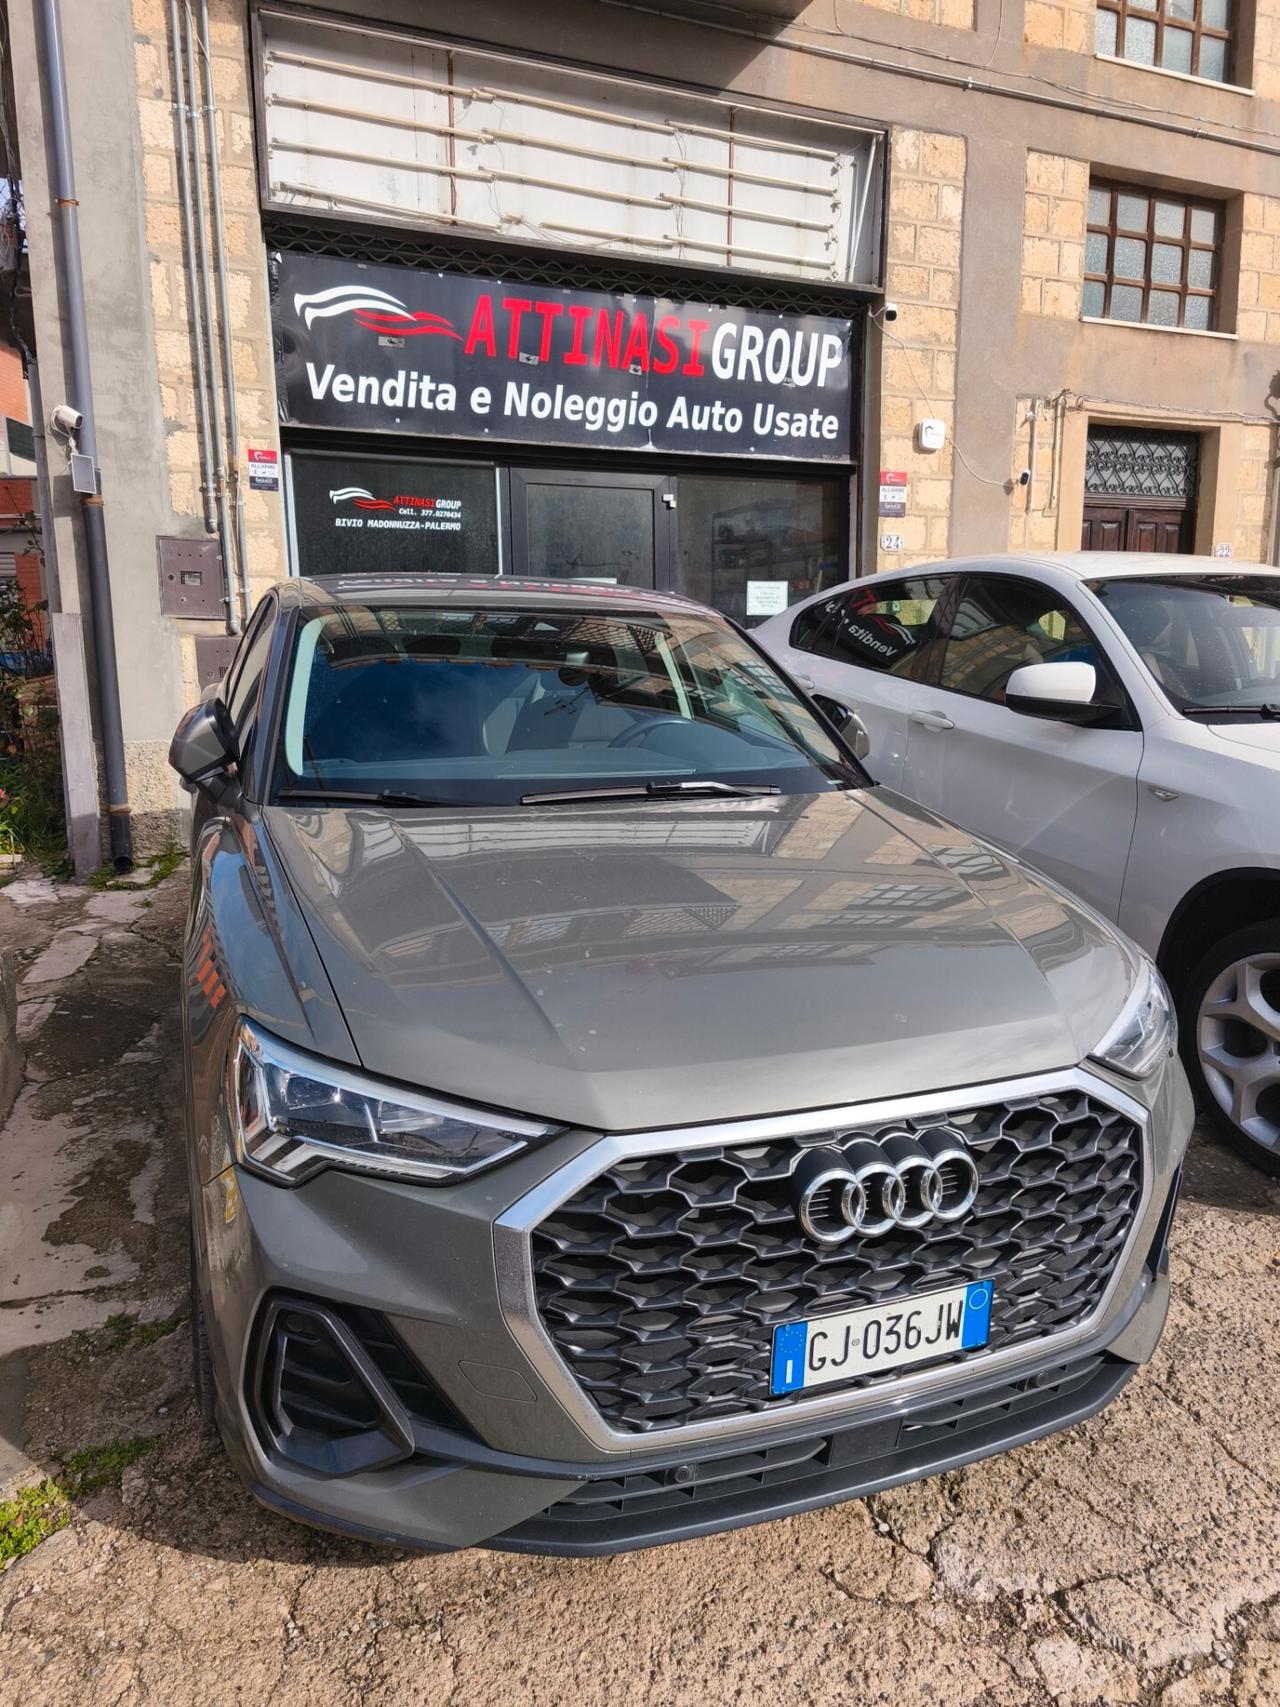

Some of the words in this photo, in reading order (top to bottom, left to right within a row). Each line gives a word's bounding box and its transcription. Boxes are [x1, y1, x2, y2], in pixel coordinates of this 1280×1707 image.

[306, 362, 457, 411] Vendita
[470, 385, 492, 414] e
[503, 381, 658, 433] Noleggio
[666, 396, 743, 433] Auto
[753, 403, 839, 439] Usate
[398, 507, 417, 516] Cell.
[335, 518, 364, 528] BIVIO
[885, 535, 901, 549] 24
